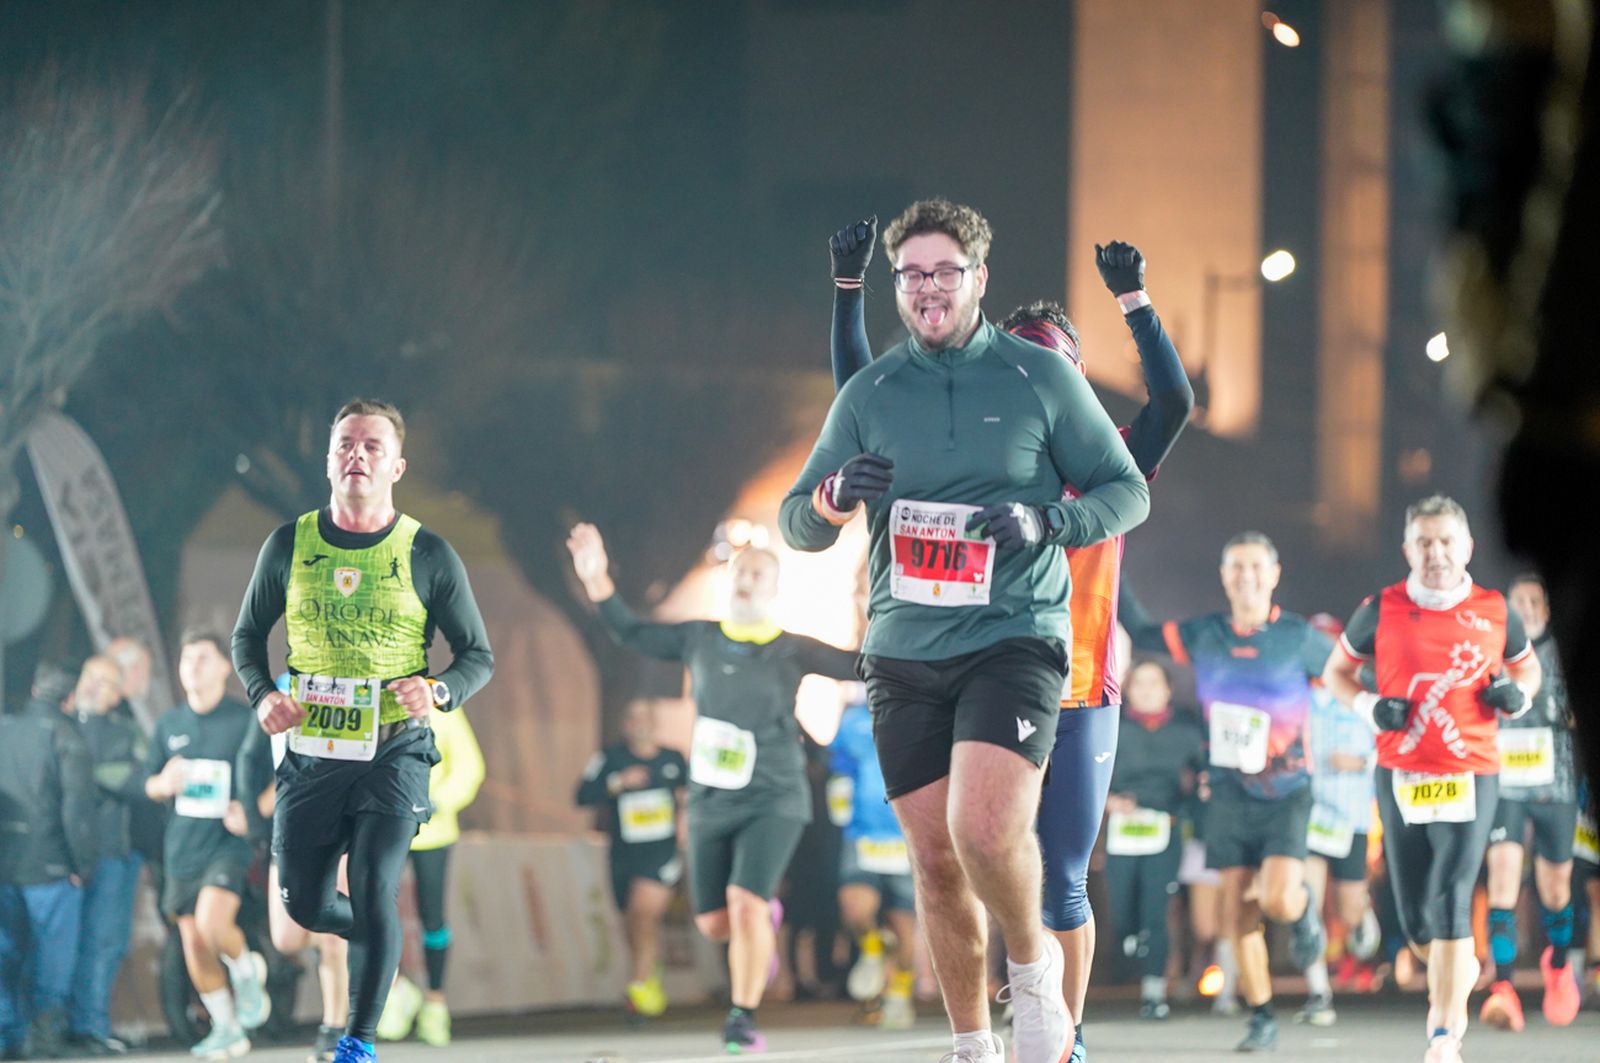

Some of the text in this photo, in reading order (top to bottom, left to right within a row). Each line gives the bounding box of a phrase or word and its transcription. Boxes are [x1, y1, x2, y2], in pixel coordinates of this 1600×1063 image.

[900, 524, 918, 535] SAN
[911, 514, 957, 526] NOCHE DE
[911, 539, 968, 571] 9716
[300, 598, 361, 623] ORO
[307, 704, 361, 732] 2009
